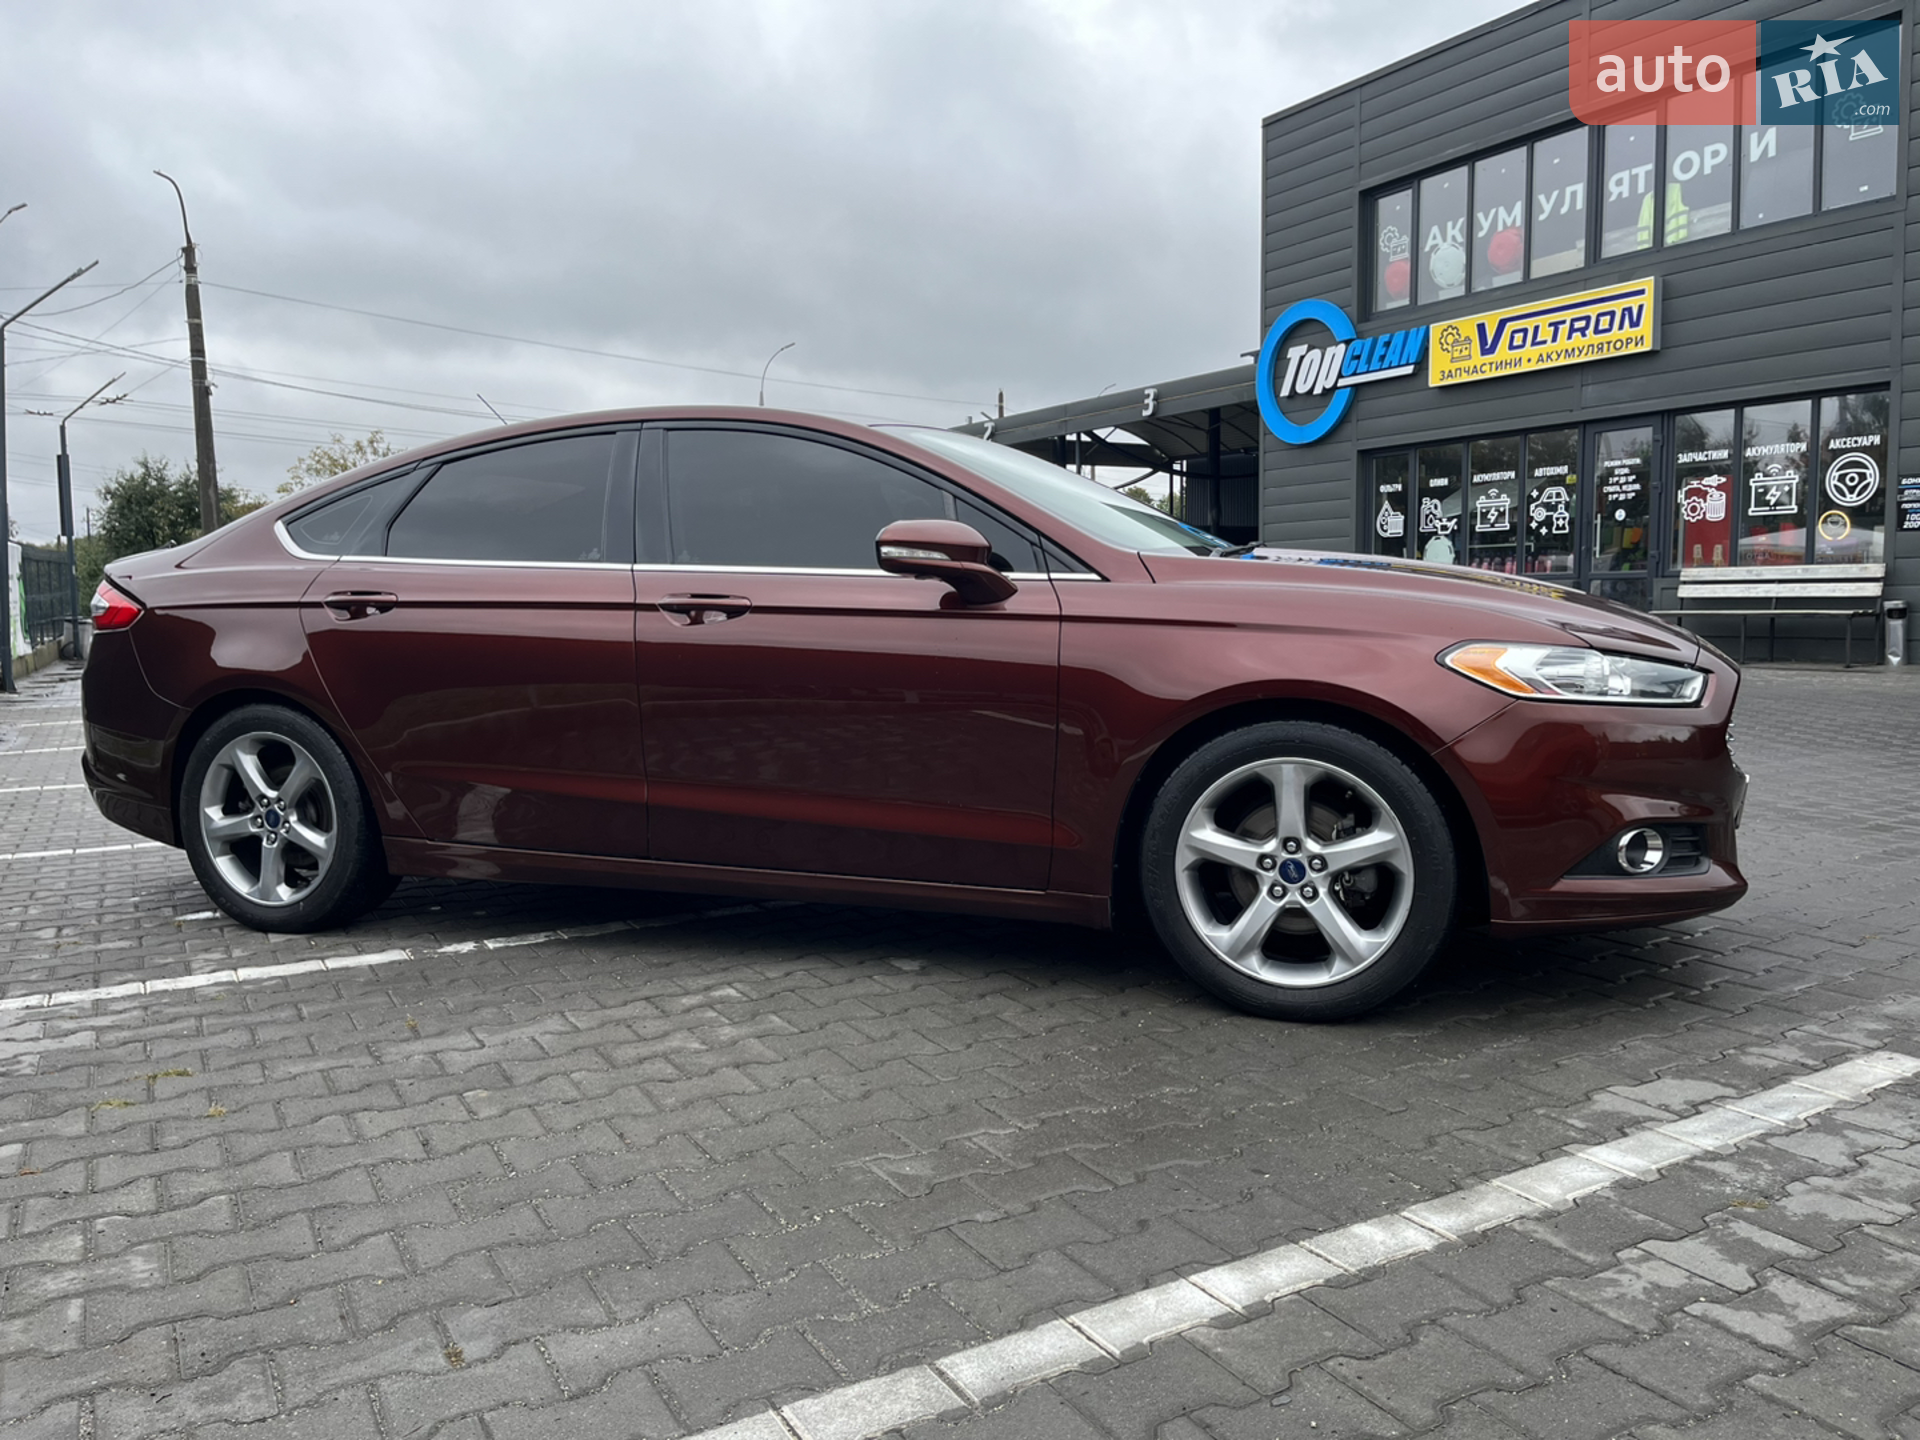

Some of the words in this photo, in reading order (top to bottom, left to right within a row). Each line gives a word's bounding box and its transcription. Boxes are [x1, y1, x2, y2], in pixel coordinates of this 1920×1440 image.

[1439, 357, 1523, 381] ЗАПЧАСТИНИ
[1536, 335, 1645, 365] АКУМУЛЯТОРИ
[1142, 388, 1157, 417] 3
[1745, 442, 1808, 458] АКУМУЛЯТОРИ
[1829, 434, 1881, 450] АКСЕСУАРИ
[1677, 449, 1729, 464] ЗАПЧАСТИНИ
